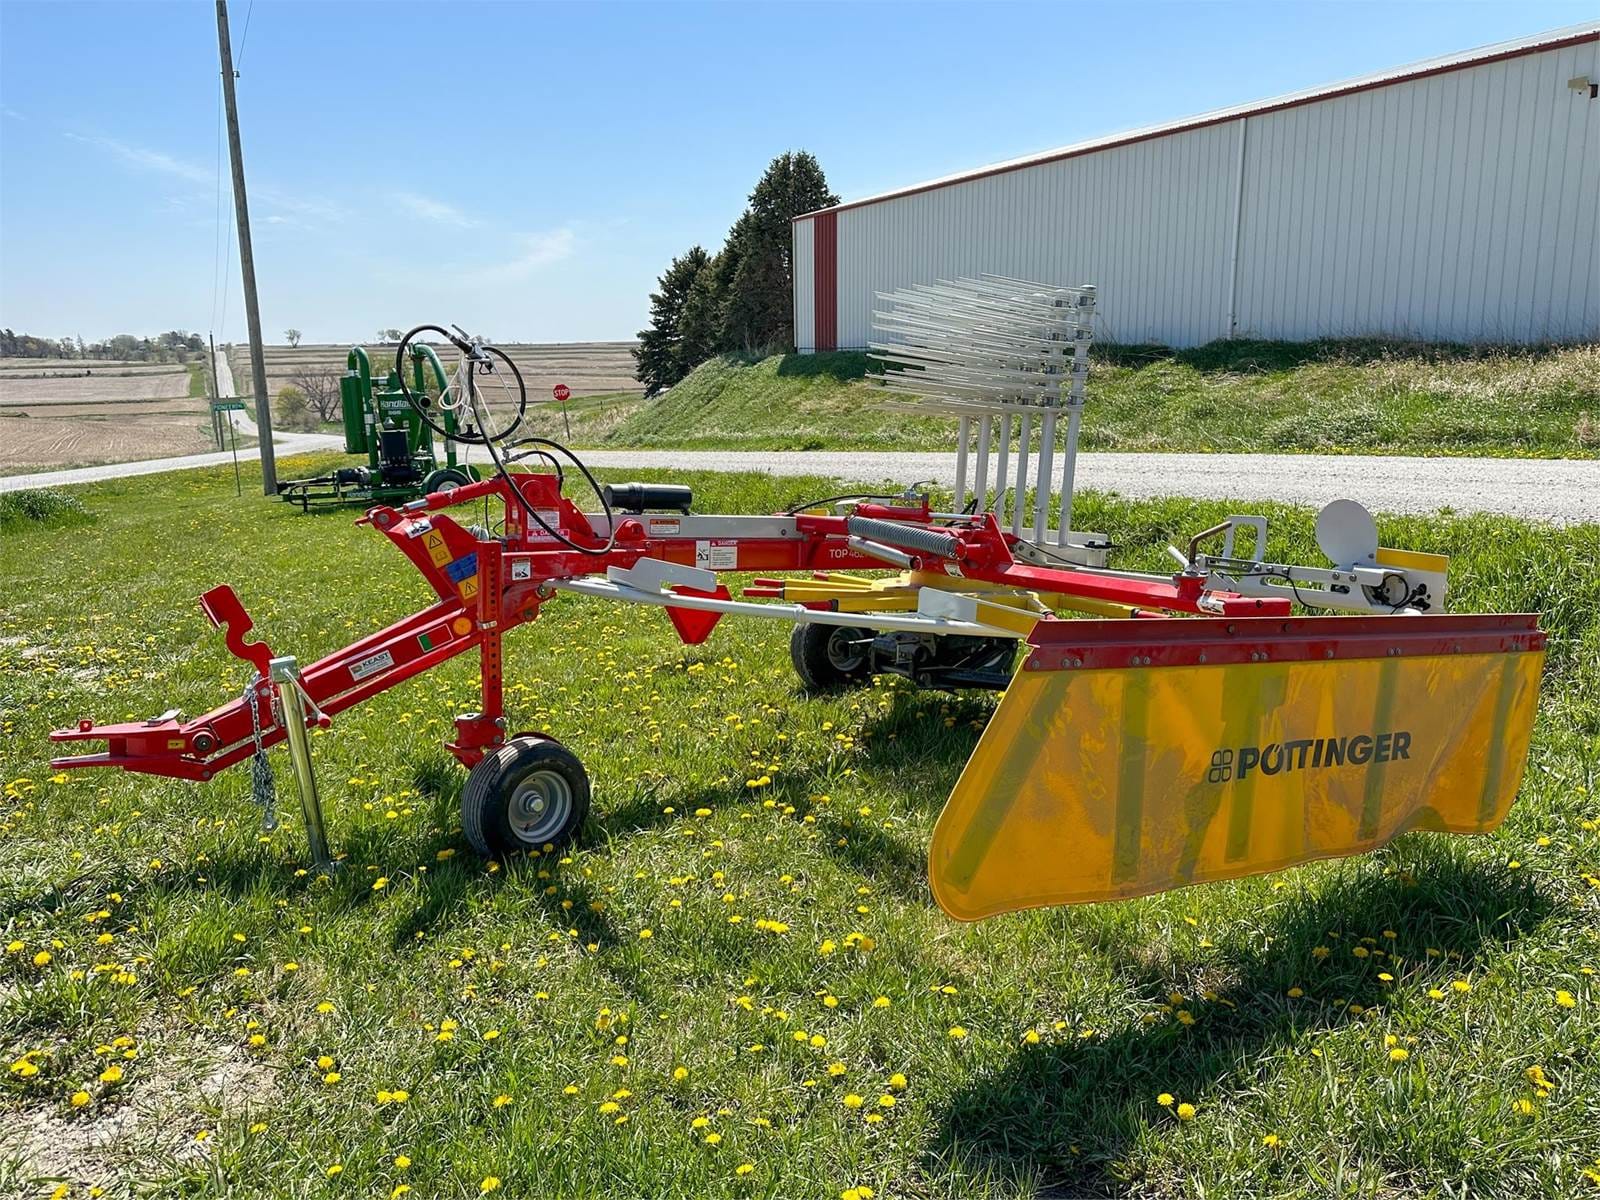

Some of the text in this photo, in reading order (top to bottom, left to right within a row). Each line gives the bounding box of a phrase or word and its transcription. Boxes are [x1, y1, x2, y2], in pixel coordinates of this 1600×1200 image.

[554, 389, 569, 397] STOP
[829, 549, 848, 559] TOP
[1237, 731, 1411, 779] PÖTTINGER
